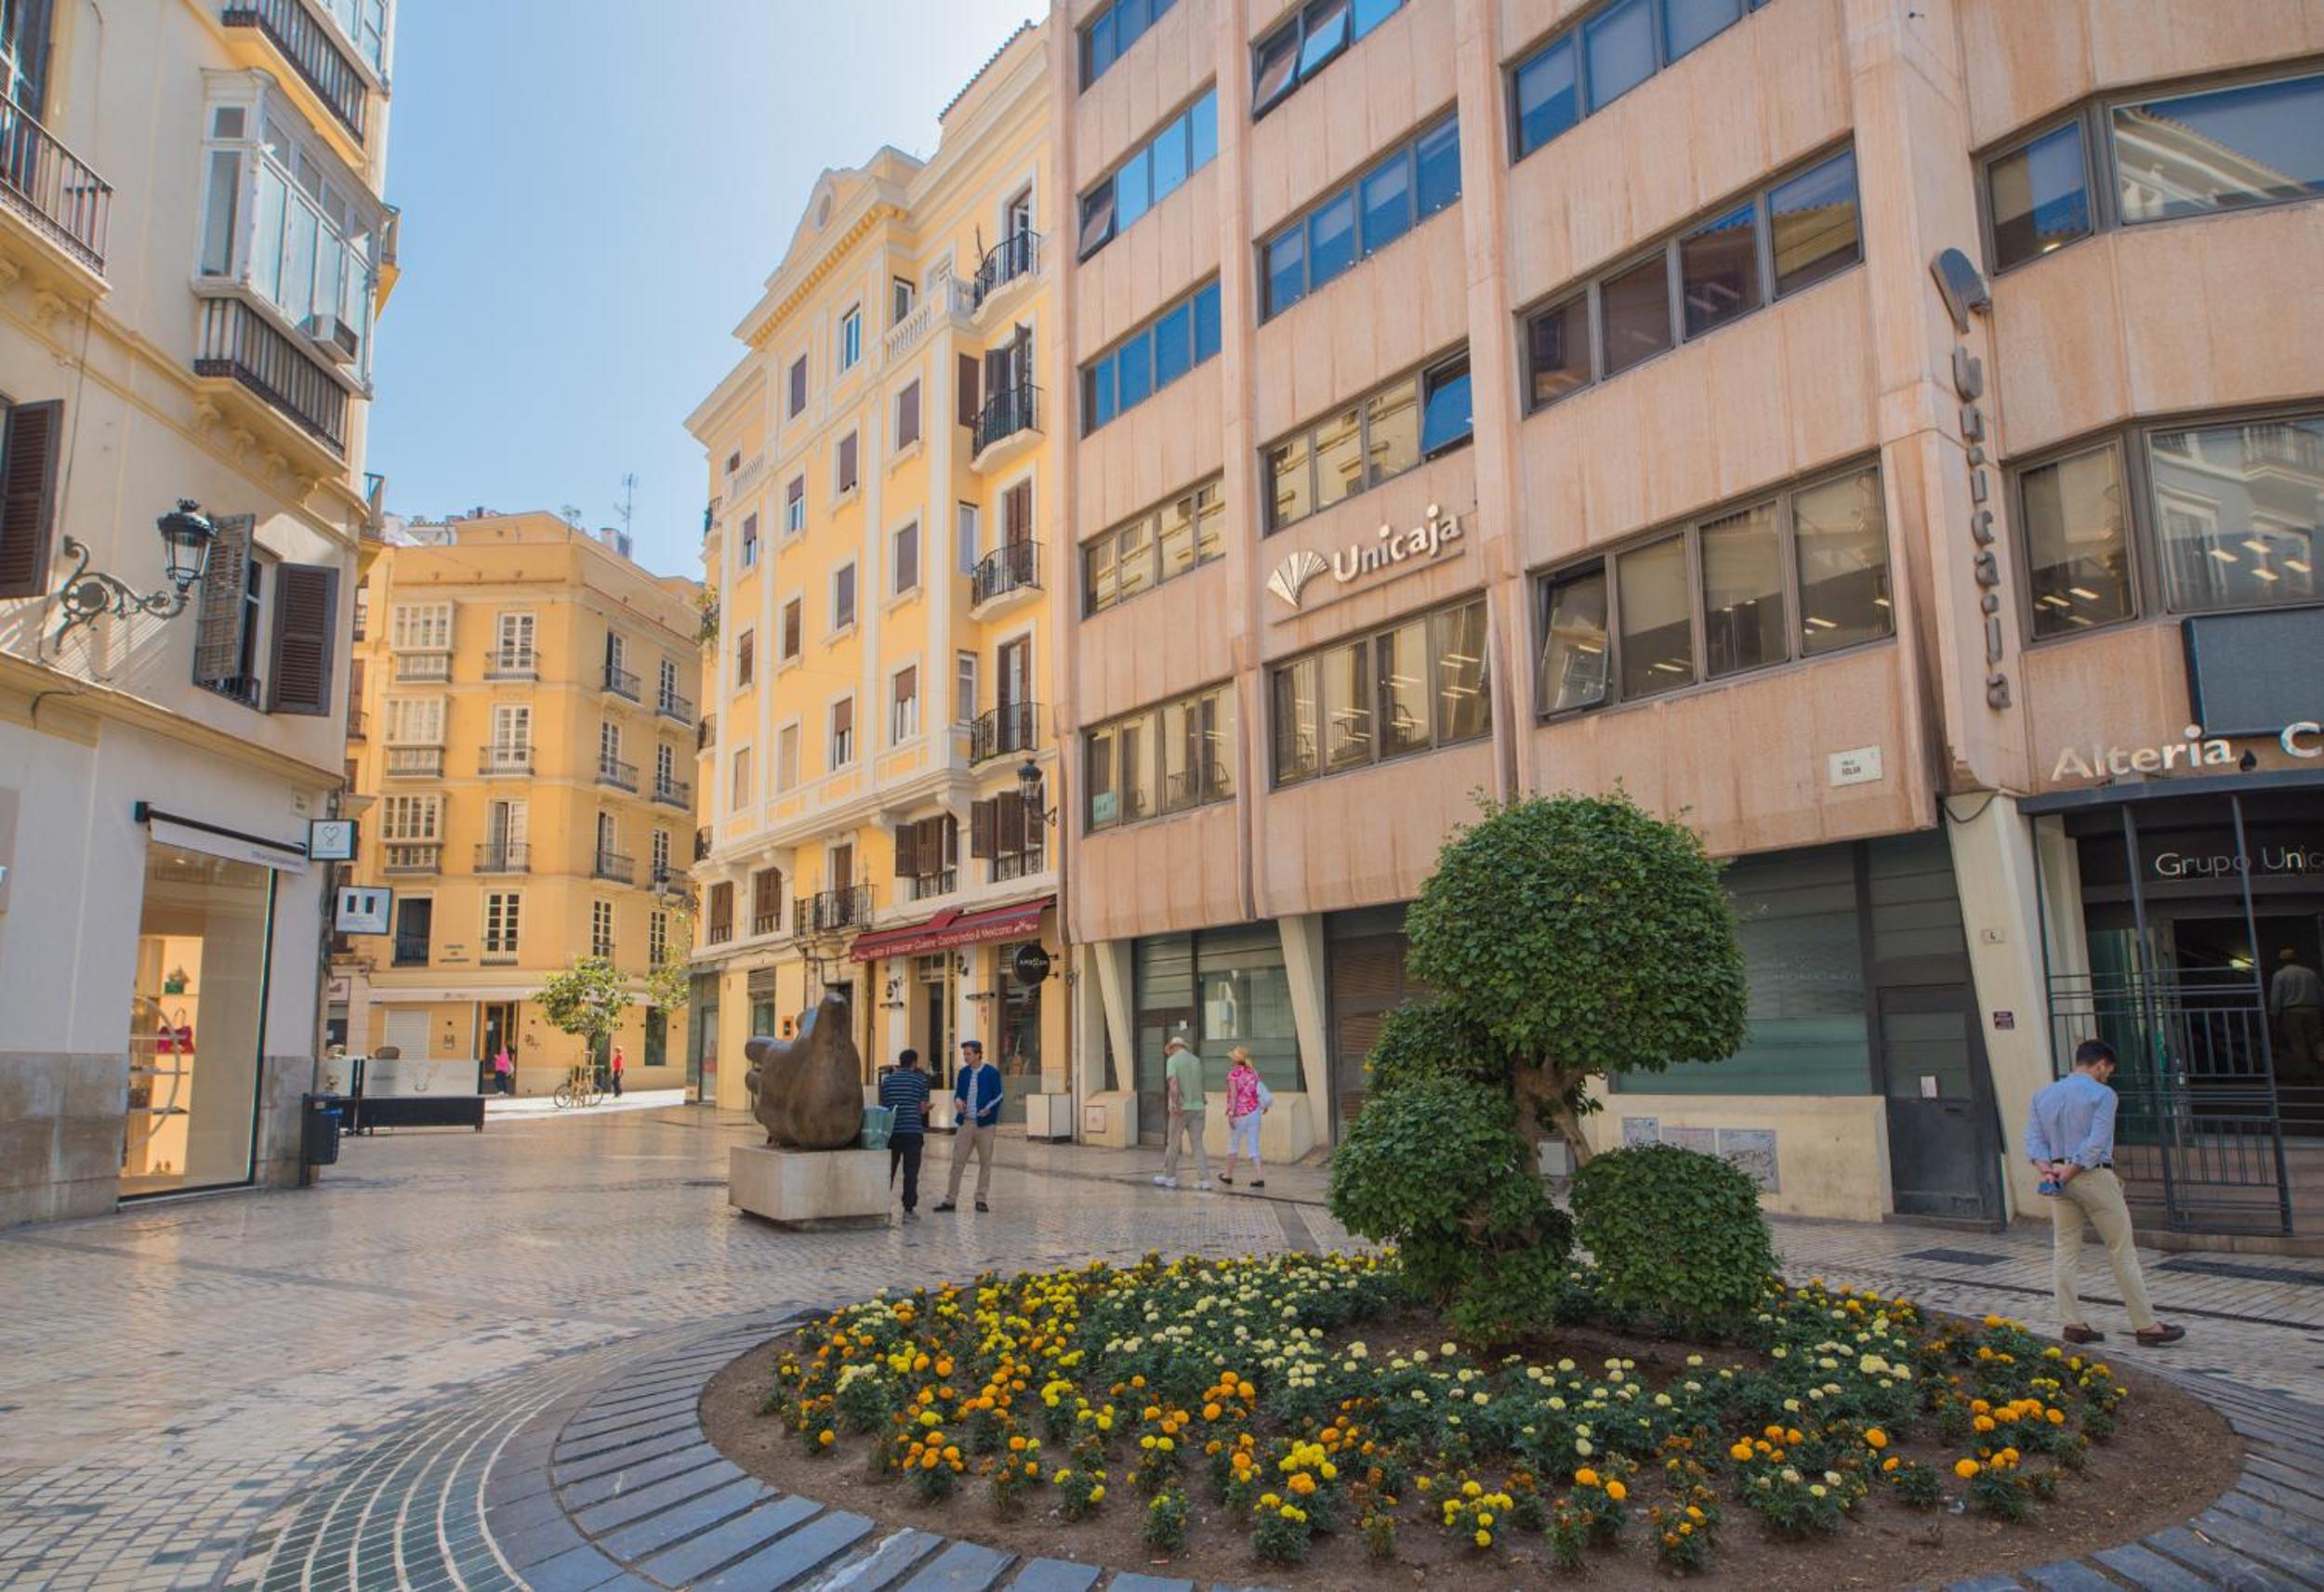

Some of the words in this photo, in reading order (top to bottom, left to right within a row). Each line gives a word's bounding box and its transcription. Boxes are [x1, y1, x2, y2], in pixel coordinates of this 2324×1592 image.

[1333, 503, 1463, 583] Unicaja
[1952, 346, 2011, 710] Unicaja
[2051, 724, 2237, 782] Alteria
[2155, 852, 2251, 877] Grupo
